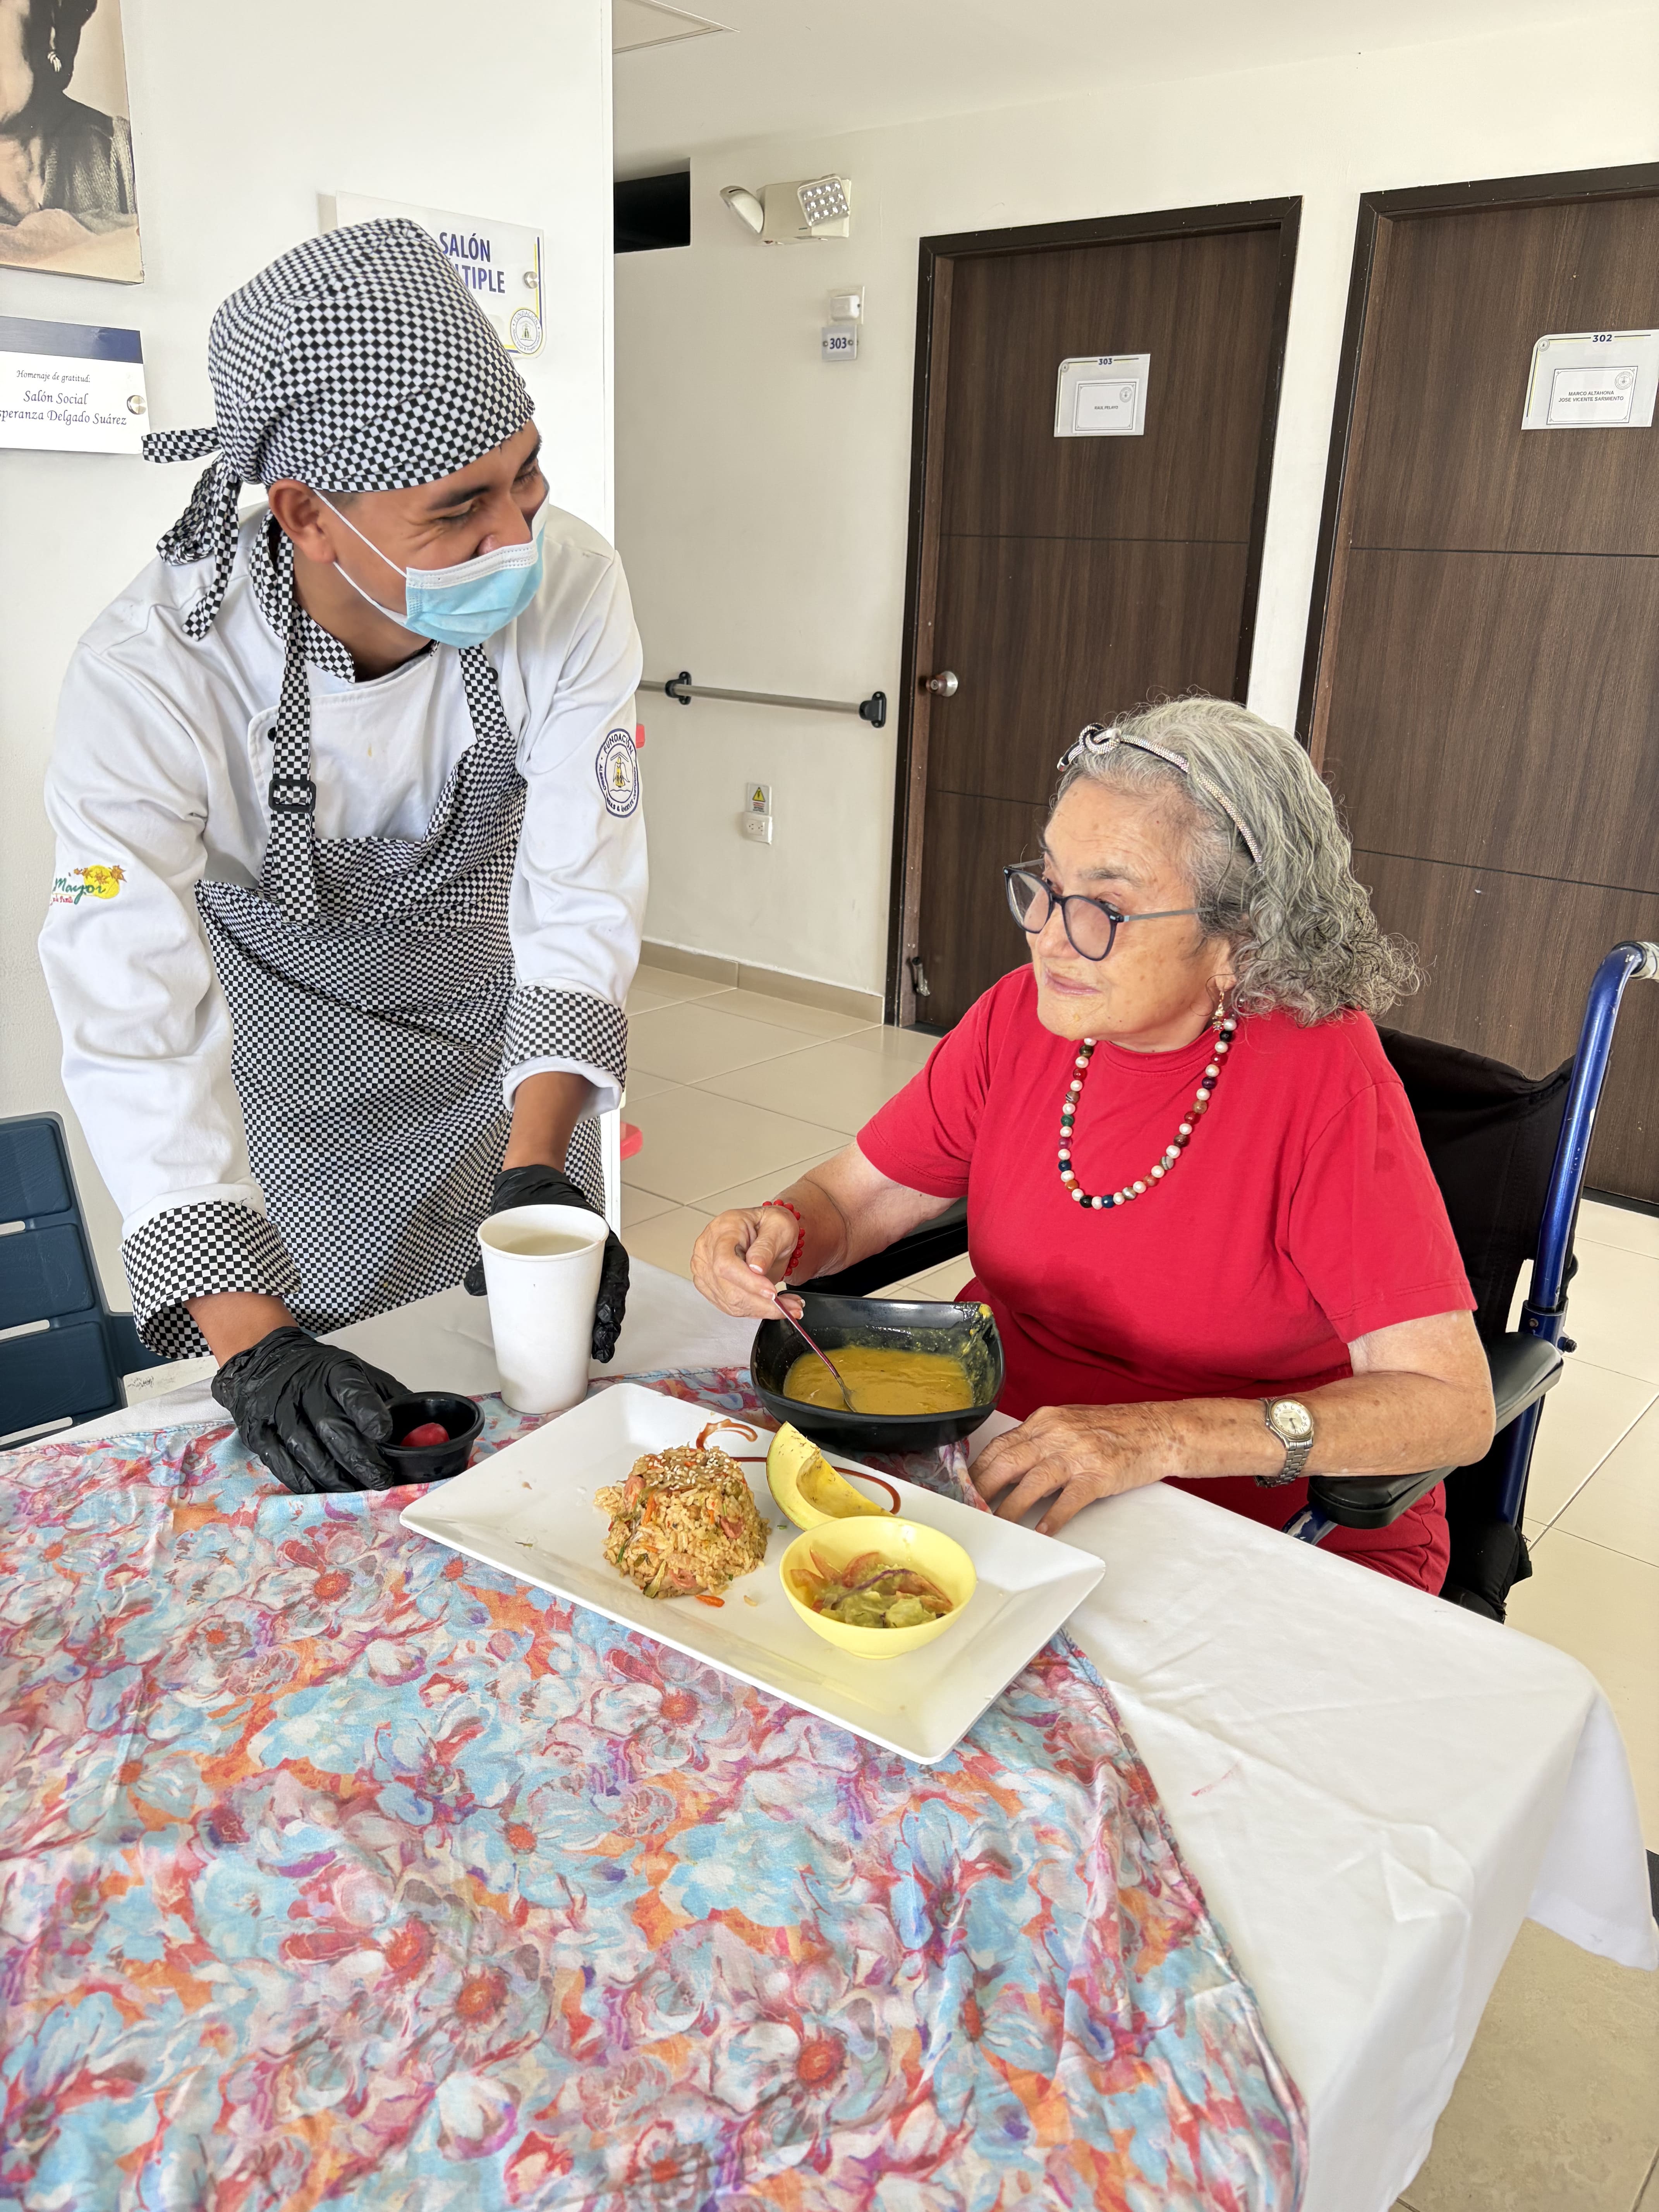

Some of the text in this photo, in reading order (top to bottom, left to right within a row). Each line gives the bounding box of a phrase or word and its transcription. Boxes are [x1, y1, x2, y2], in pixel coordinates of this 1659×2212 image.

[440, 232, 490, 262] SALÓN
[455, 264, 505, 294] TIPLE
[830, 338, 847, 349] 303
[1592, 334, 1612, 342] 302
[17, 370, 90, 383] Homenaje de gratitud:
[23, 390, 89, 405] Salón Social
[47, 410, 90, 425] Delgado
[93, 414, 127, 425] Suárez
[53, 878, 106, 905] Mayor
